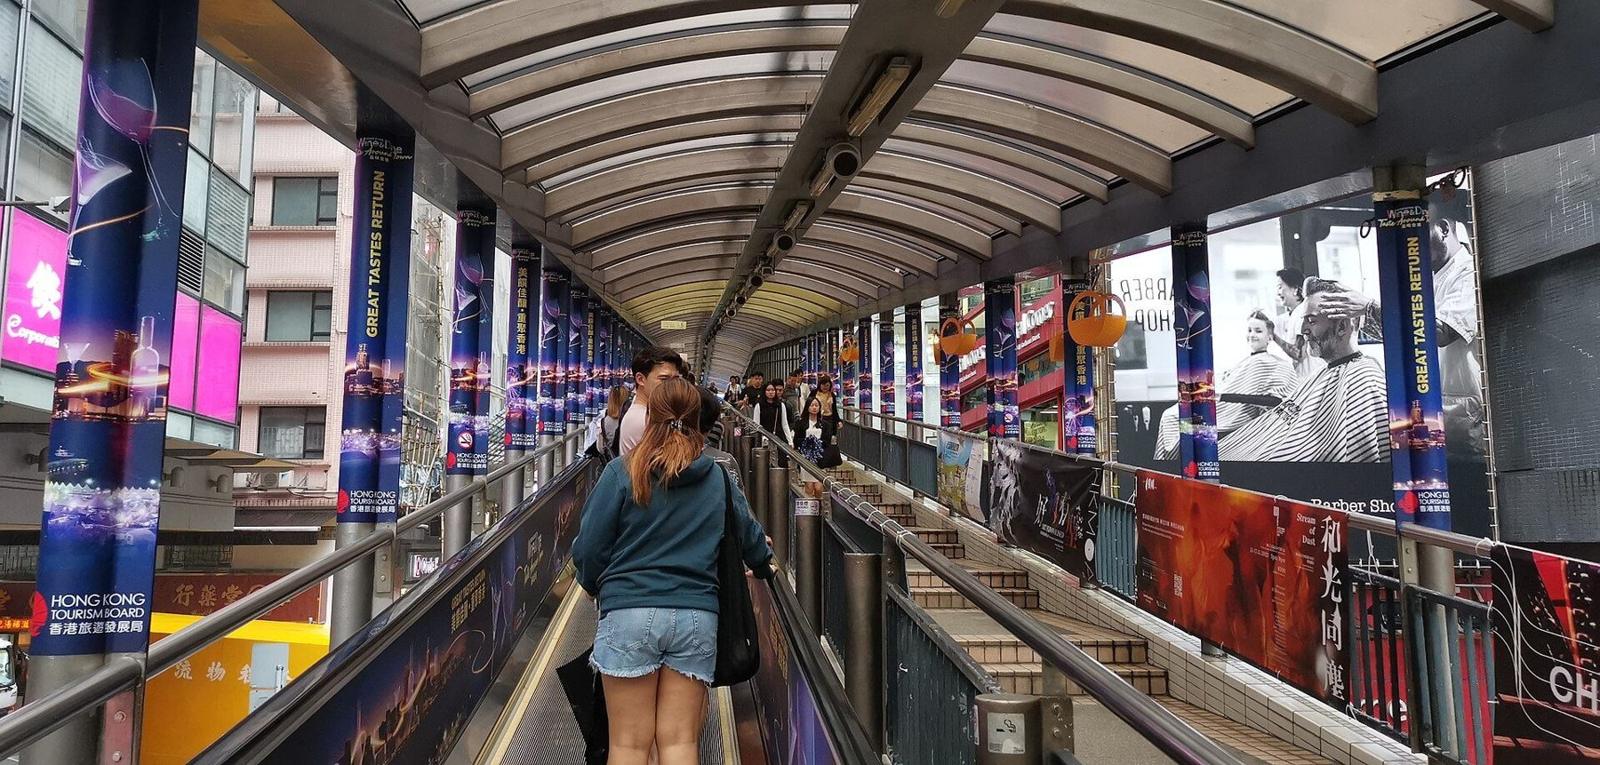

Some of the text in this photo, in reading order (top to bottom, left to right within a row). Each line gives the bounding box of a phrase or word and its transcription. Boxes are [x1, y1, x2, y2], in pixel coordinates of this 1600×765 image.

[367, 171, 385, 337] GREAT TASTES RETURN
[1407, 236, 1430, 394] GREAT TASTES RETURN
[350, 490, 374, 498] HONG
[1418, 491, 1442, 499] HONG
[1370, 499, 1395, 513] Sh
[1296, 512, 1316, 525] Stream
[1308, 526, 1316, 535] of
[1302, 535, 1316, 546] Dust
[51, 593, 146, 607] HONG KONG
[51, 607, 145, 620] TOURISM BOARD
[1319, 515, 1344, 701] 和光同塵
[49, 620, 144, 635] 香港旅遊發展局
